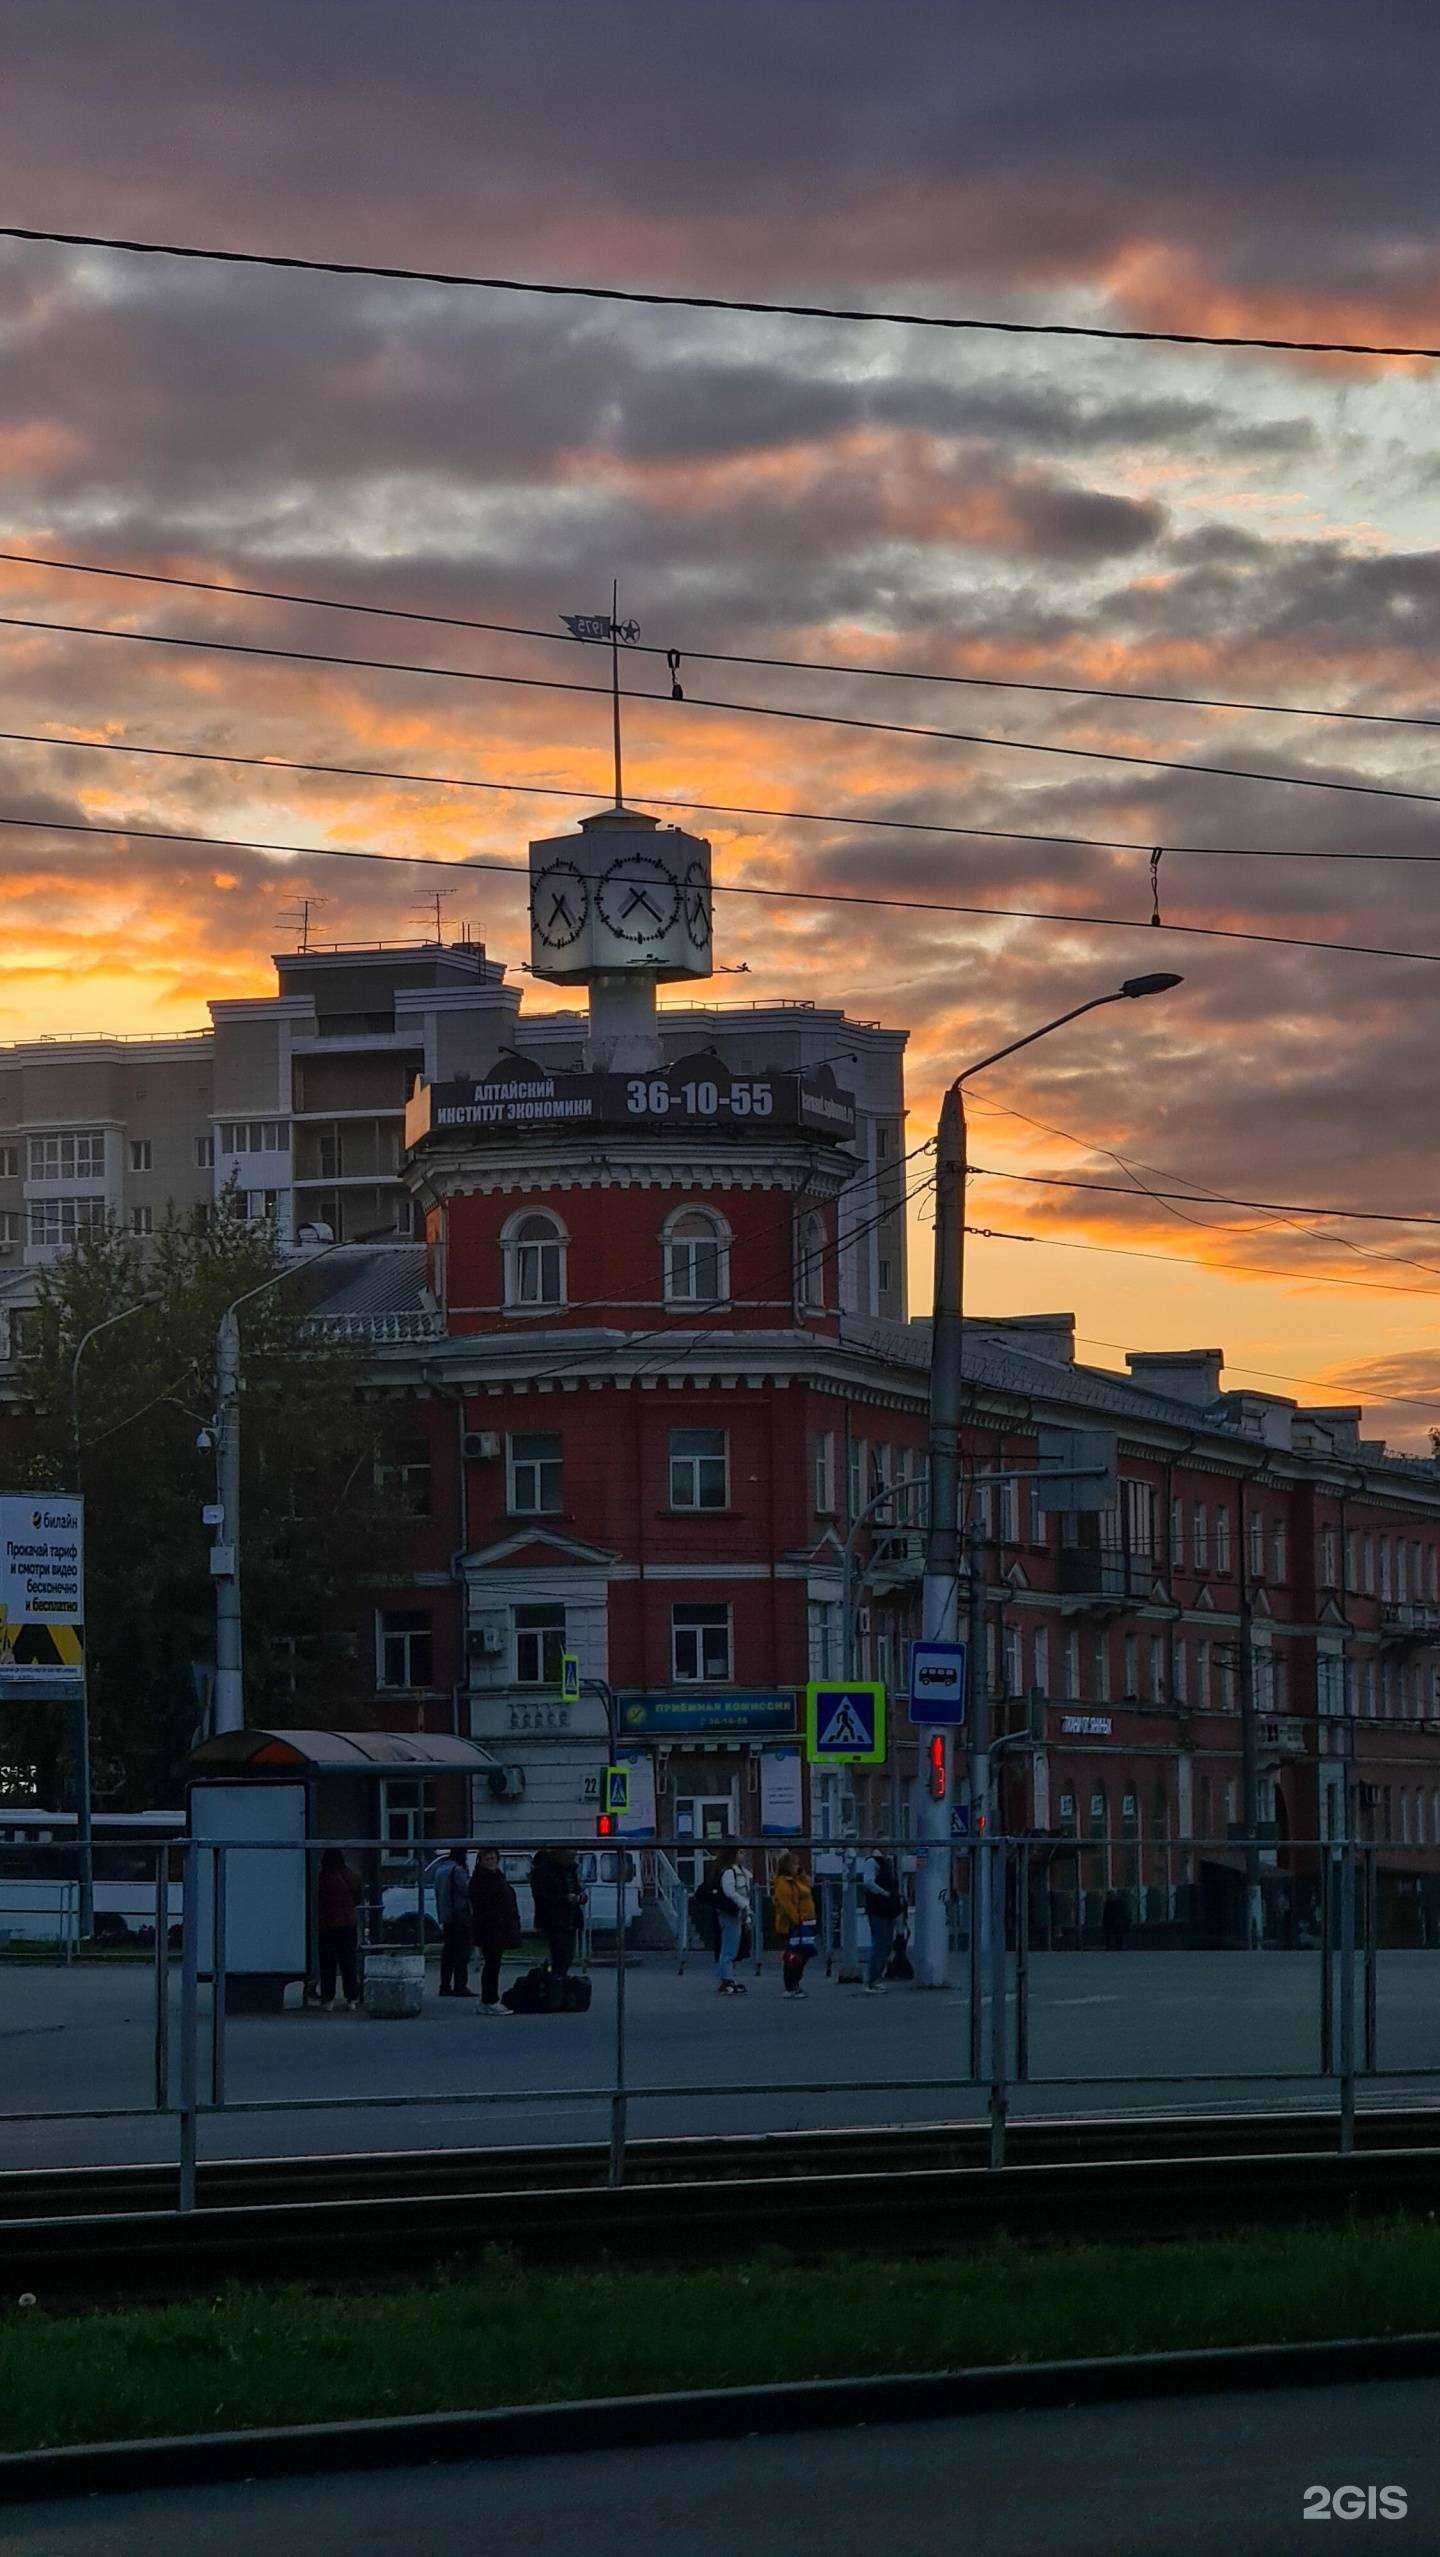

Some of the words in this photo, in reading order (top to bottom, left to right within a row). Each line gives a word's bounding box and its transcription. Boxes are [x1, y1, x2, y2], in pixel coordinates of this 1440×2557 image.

[474, 1079, 555, 1102] АЛТАЙСКИЙ
[626, 1080, 772, 1116] 36-10-55
[437, 1104, 504, 1125] ИНСТИТУТ
[506, 1098, 593, 1121] ЭКОНОМИКИ
[43, 1511, 79, 1529] билайн
[6, 1541, 48, 1559] Прокачай
[49, 1543, 78, 1561] тариф
[18, 1563, 50, 1578] смотри
[51, 1565, 78, 1578] видео
[26, 1579, 78, 1594] бесконечно
[584, 1777, 597, 1794] 22
